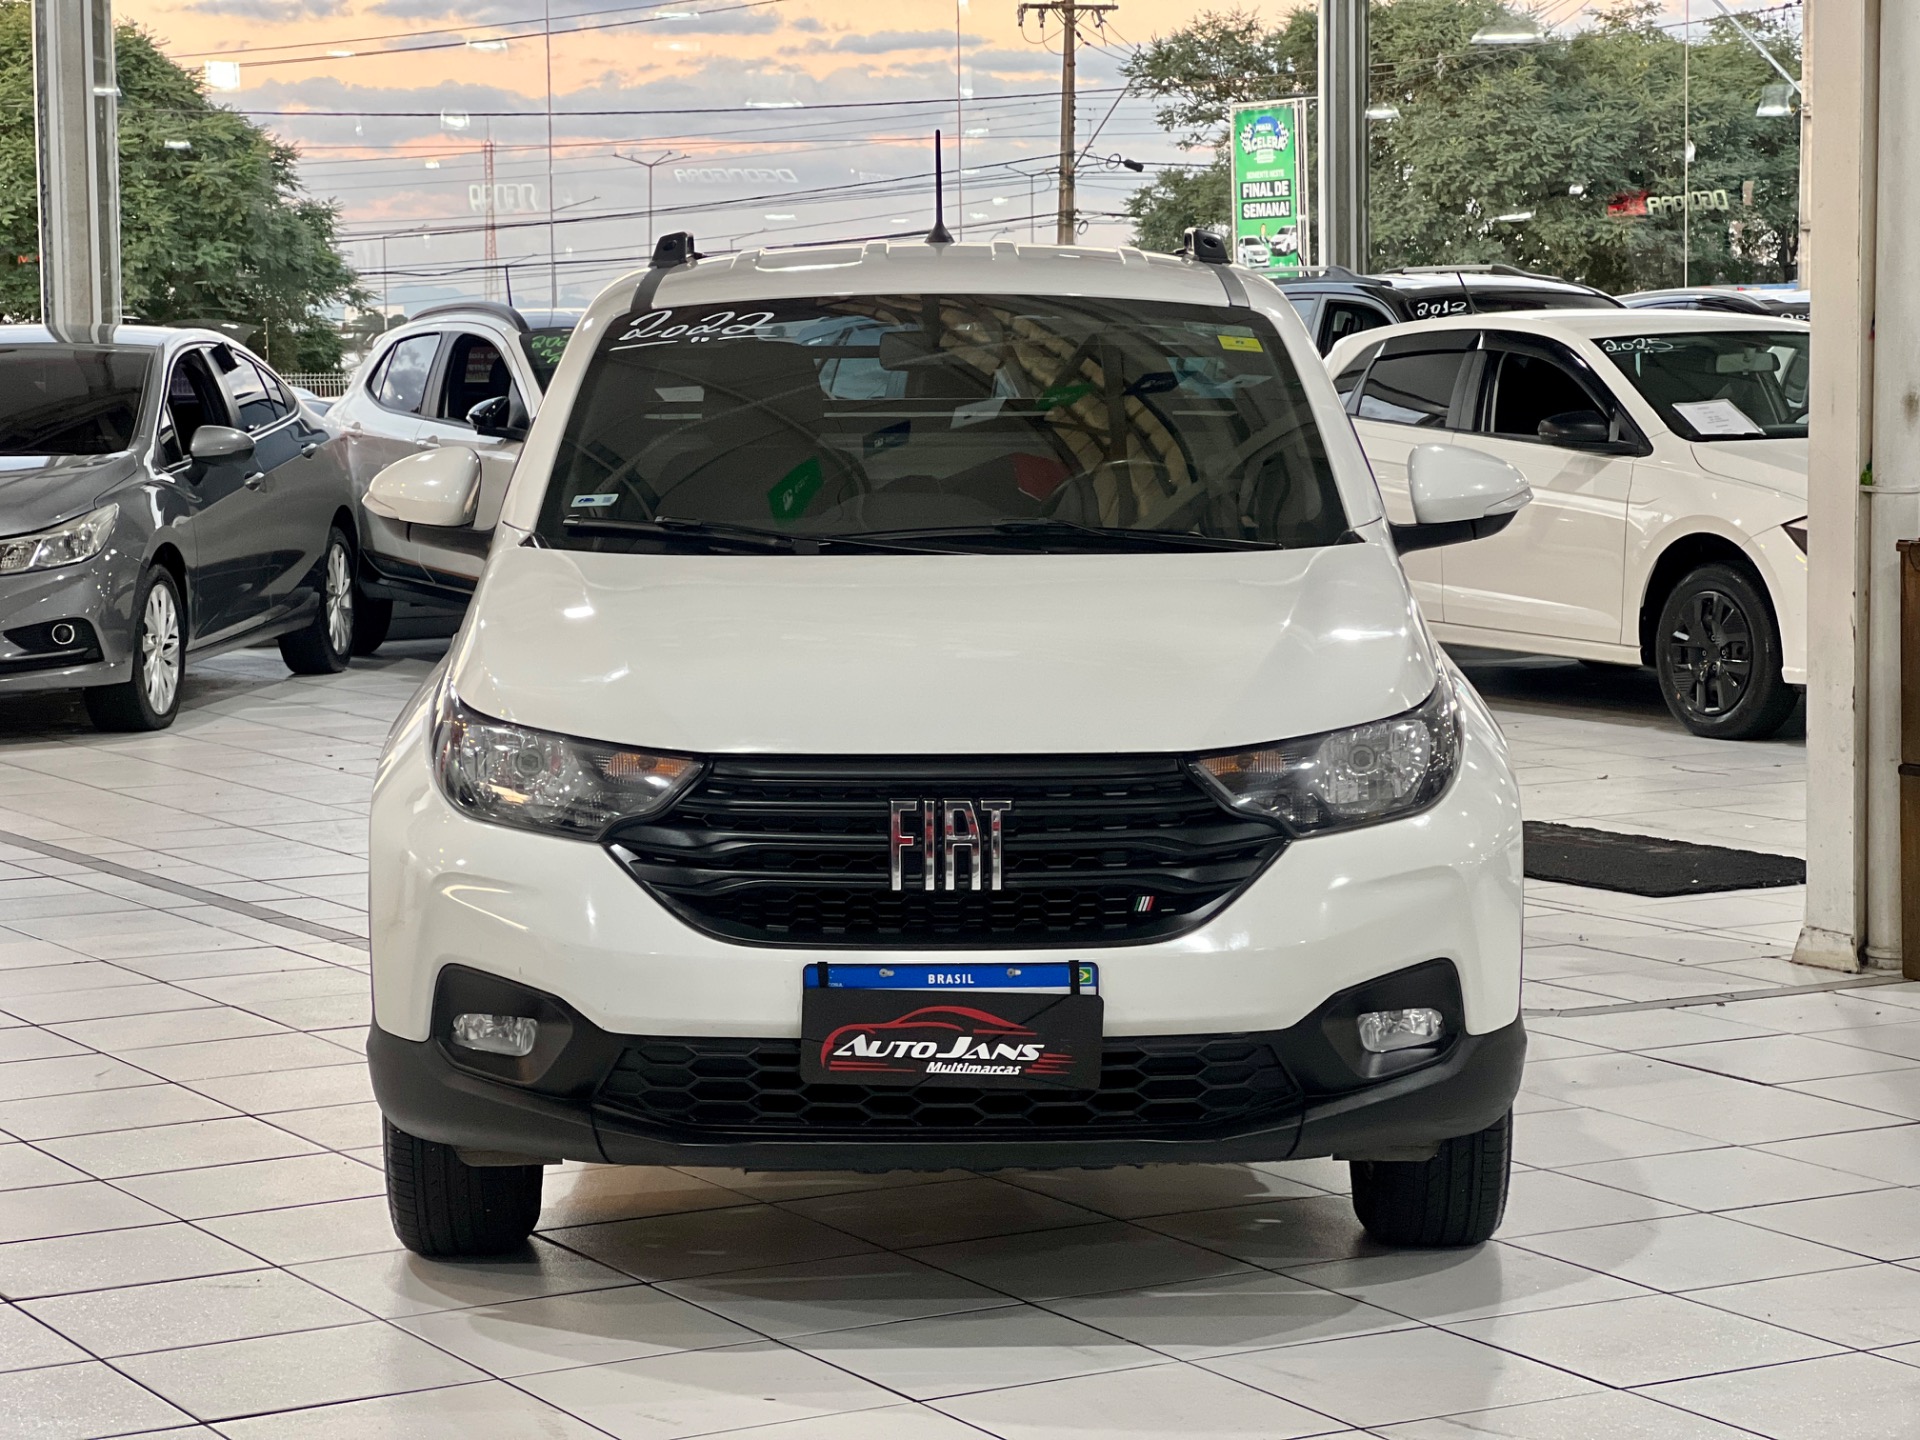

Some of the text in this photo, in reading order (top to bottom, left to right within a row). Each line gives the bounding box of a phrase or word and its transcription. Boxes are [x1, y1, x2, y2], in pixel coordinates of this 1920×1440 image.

[1242, 180, 1290, 198] FINAL DE
[1243, 201, 1290, 218] SEMANA!
[1417, 300, 1467, 316] 2012
[618, 310, 775, 341] 2022
[890, 800, 1012, 891] FIAT
[928, 974, 975, 984] BRASIL
[926, 1061, 1021, 1076] Multimarcas
